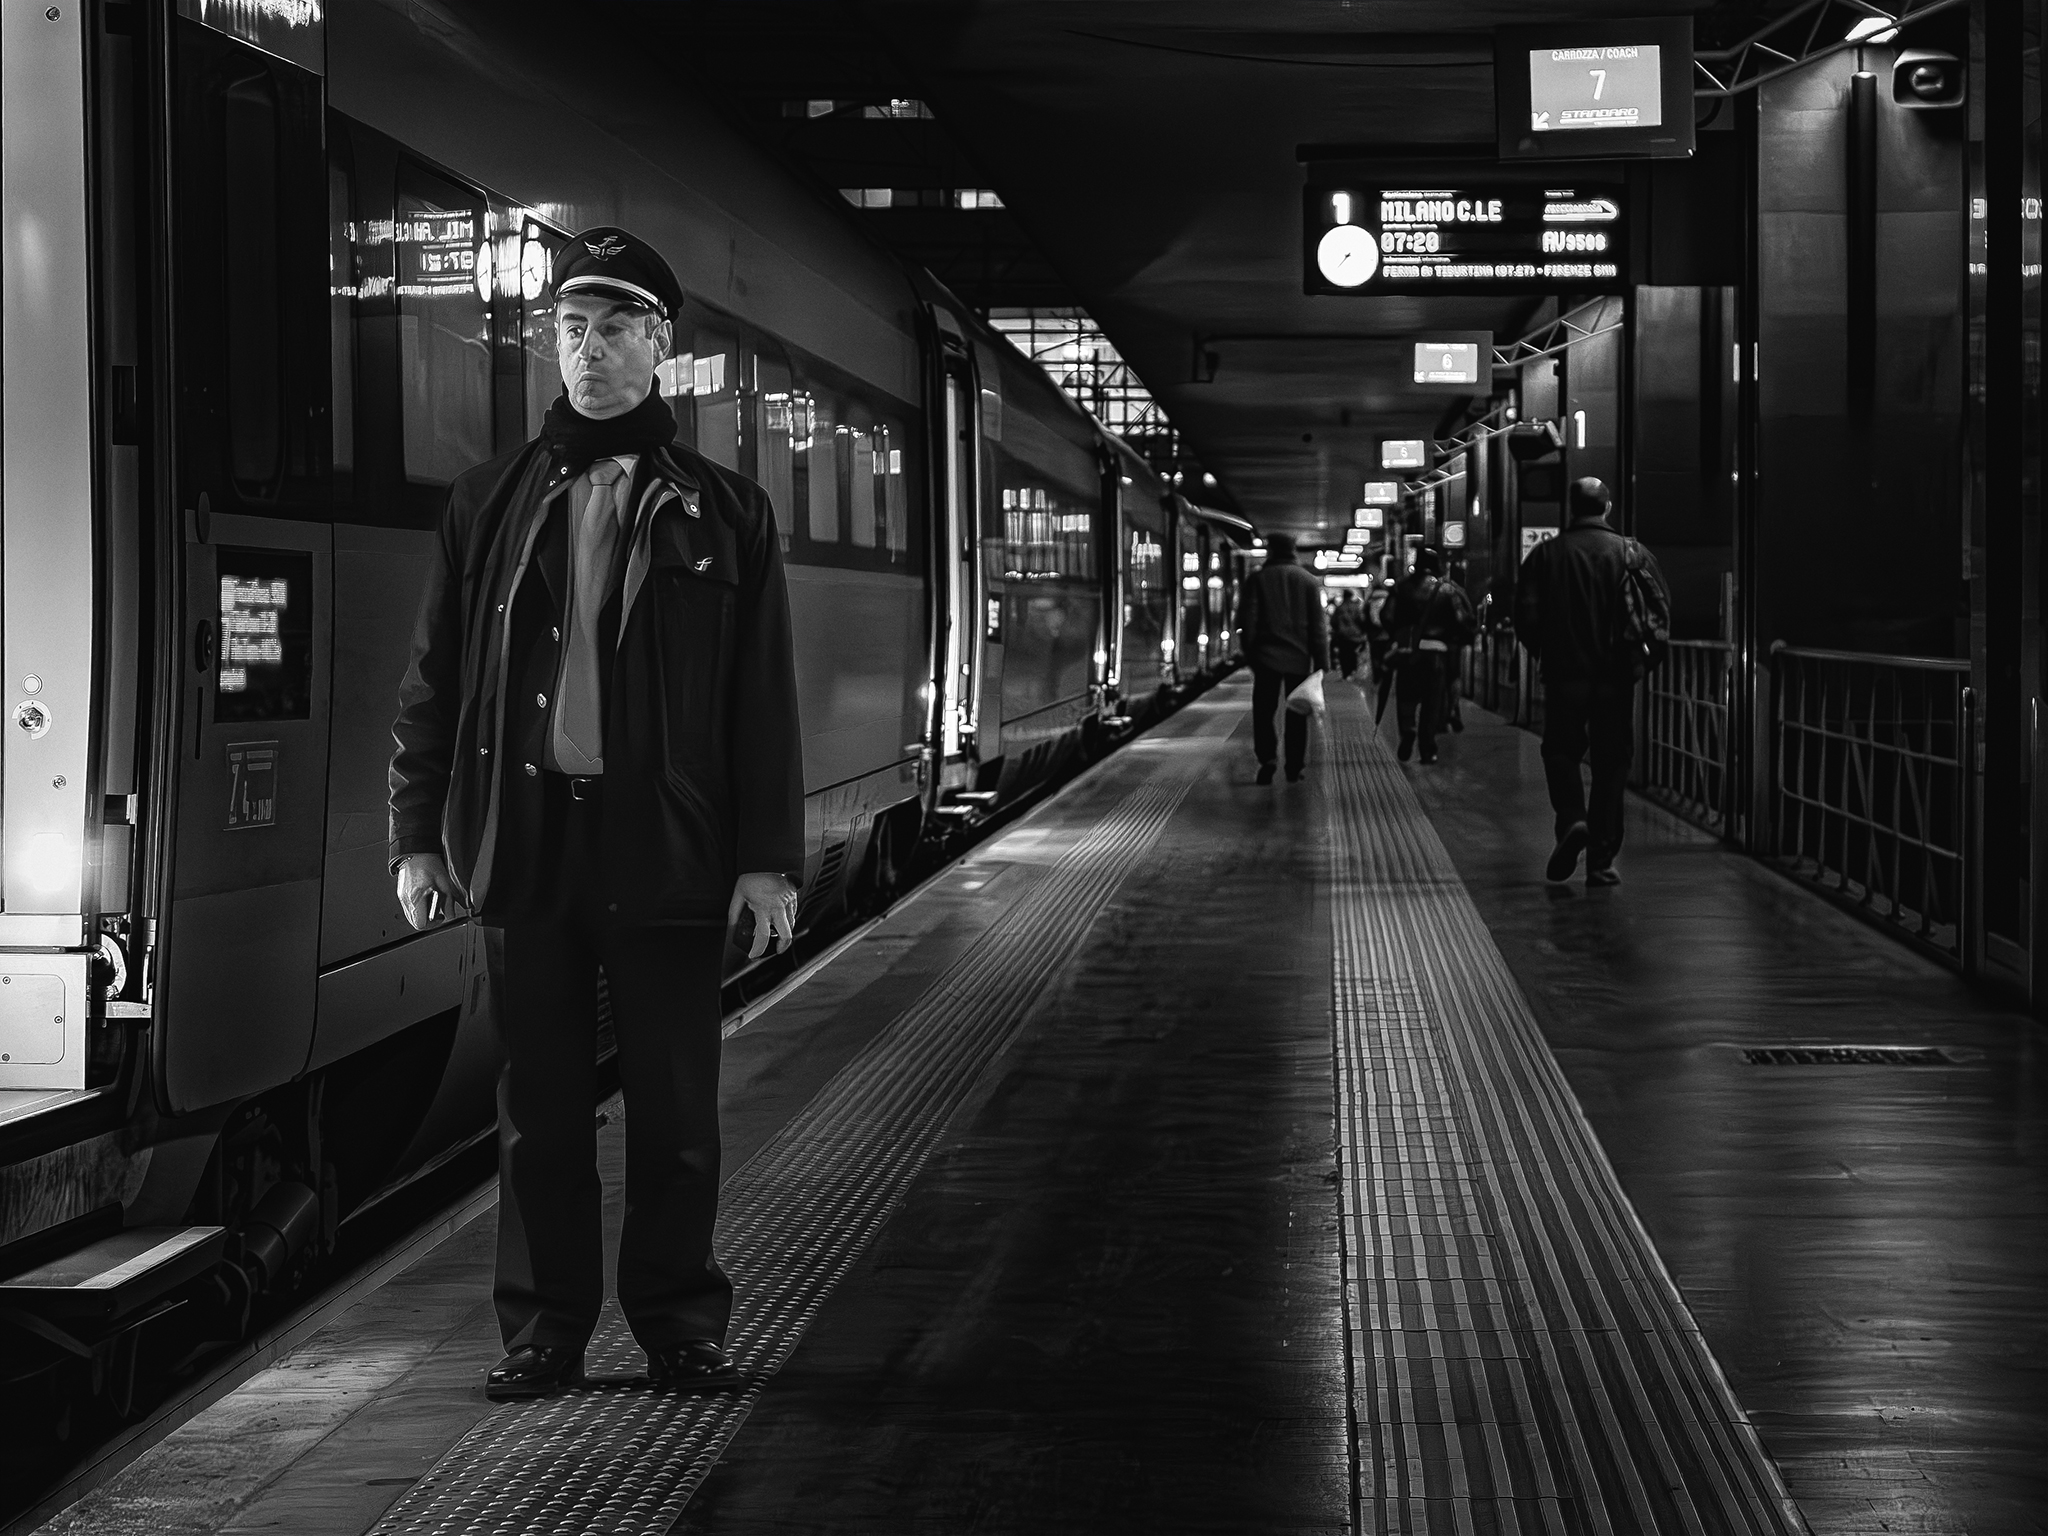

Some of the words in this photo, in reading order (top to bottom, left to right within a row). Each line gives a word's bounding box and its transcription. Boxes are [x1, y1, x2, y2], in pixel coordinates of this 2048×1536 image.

[1552, 49, 1599, 60] CARROZZA
[1607, 48, 1638, 59] COACH
[1589, 70, 1606, 101] 7
[1561, 108, 1638, 118] STANDARD
[1332, 193, 1350, 224] 1
[1380, 200, 1455, 222] MILANO
[1457, 200, 1502, 222] C.LE
[1381, 232, 1439, 253] 07:20
[1544, 265, 1591, 277] FIRENZE
[1442, 353, 1453, 370] 6
[1573, 410, 1586, 449] 1
